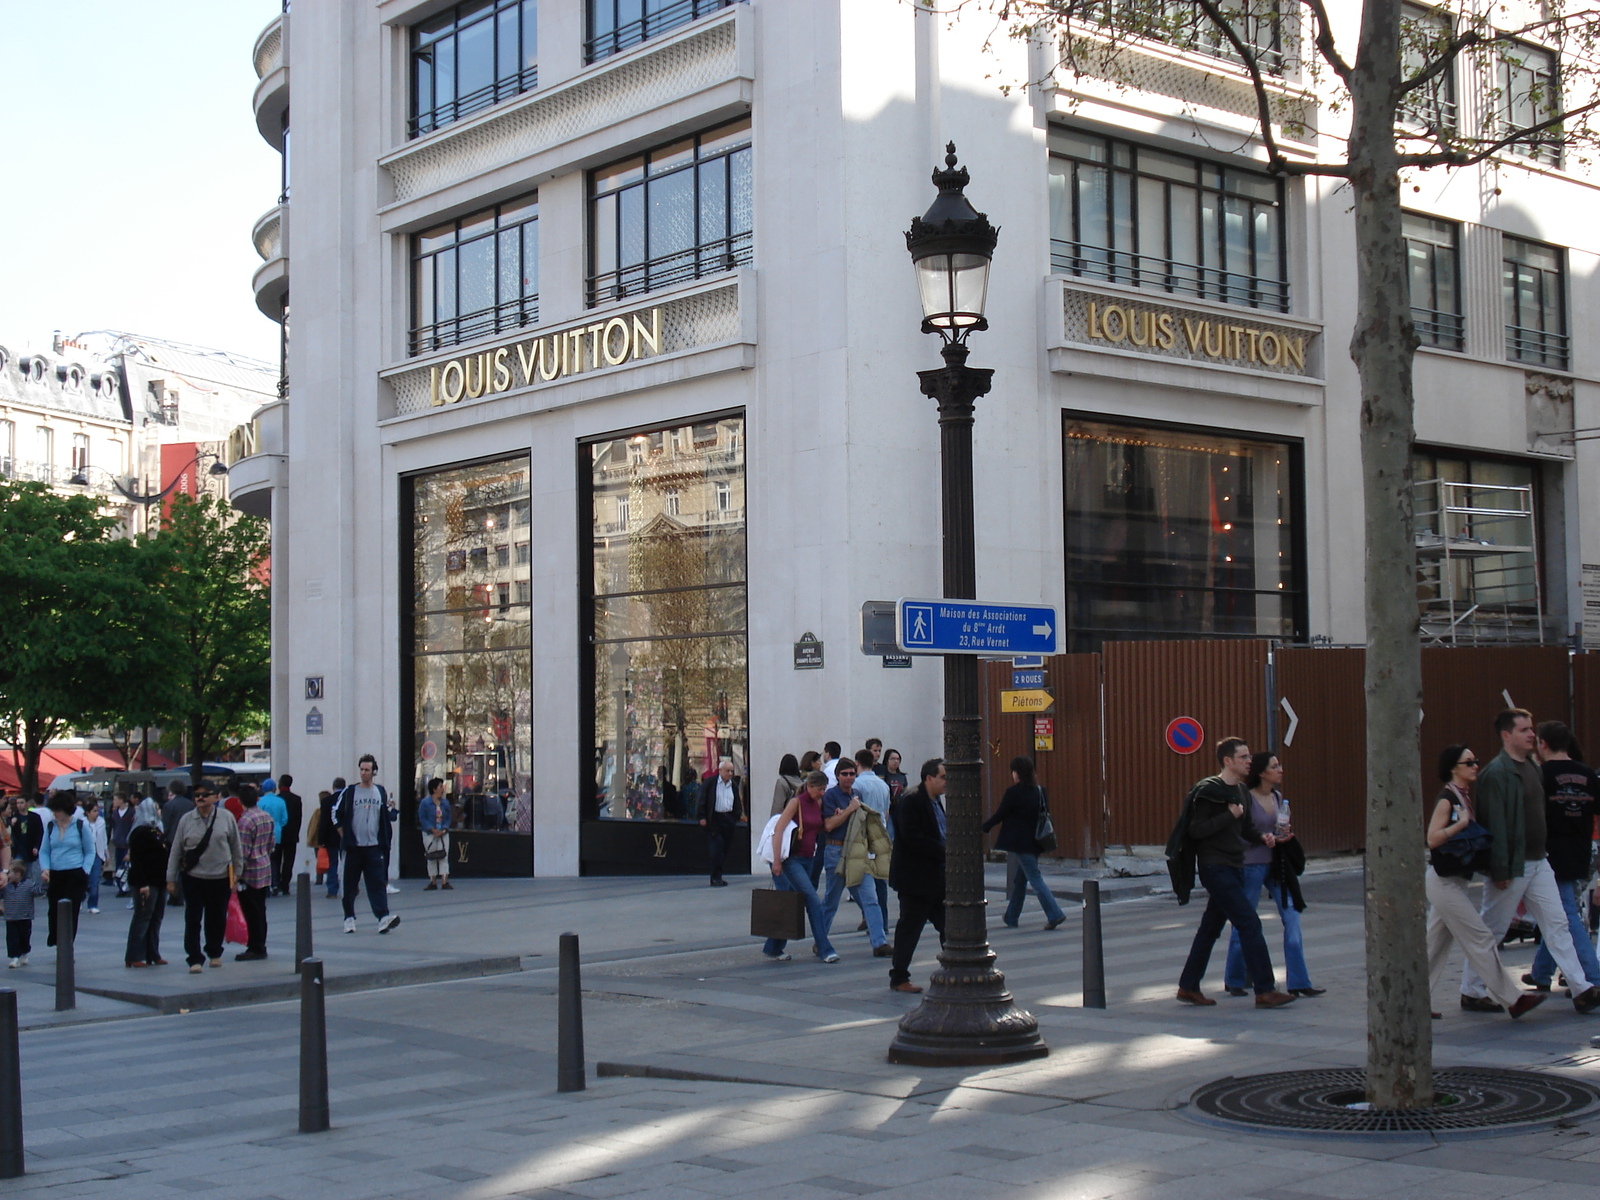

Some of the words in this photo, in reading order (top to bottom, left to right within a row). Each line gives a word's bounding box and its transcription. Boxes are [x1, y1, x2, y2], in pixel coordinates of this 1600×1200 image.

[1087, 302, 1176, 350] LOUIS
[1181, 317, 1305, 370] VUITTON
[430, 347, 513, 407] LOUIS
[516, 308, 663, 386] VUITTON
[940, 607, 966, 619] Maison
[967, 609, 980, 620] des
[982, 609, 1027, 622] Associations
[962, 622, 971, 633] du
[987, 623, 1006, 634] Arrdt
[986, 637, 1010, 648] Vernet
[1014, 675, 1020, 684] 2
[1021, 674, 1042, 684] ROUES
[1012, 696, 1043, 707] Piétons
[354, 798, 380, 806] CANADA
